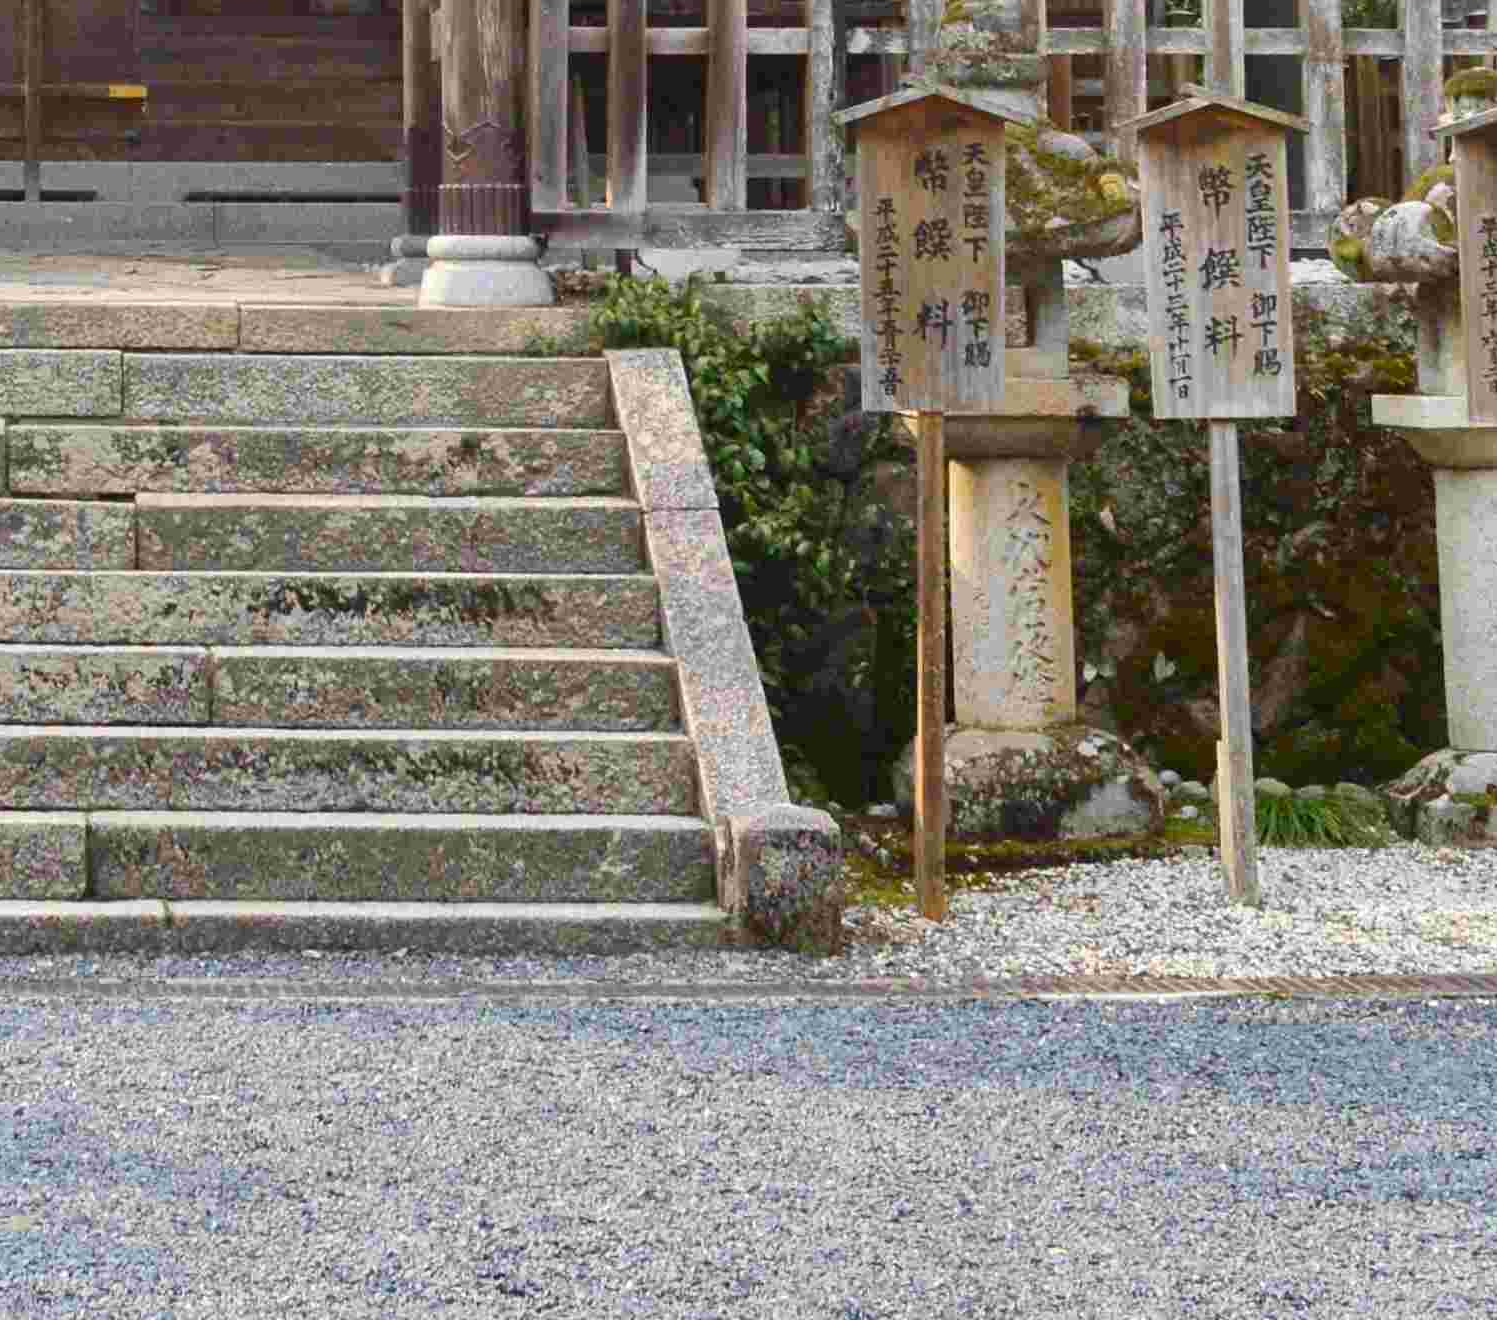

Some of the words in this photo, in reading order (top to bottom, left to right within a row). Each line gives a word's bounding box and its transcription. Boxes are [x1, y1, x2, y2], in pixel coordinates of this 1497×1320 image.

[962, 142, 990, 263] 天皇陛下
[1245, 153, 1278, 270] 天皇陛下
[961, 290, 992, 368] 御下賜
[1250, 292, 1282, 376] 御下賜
